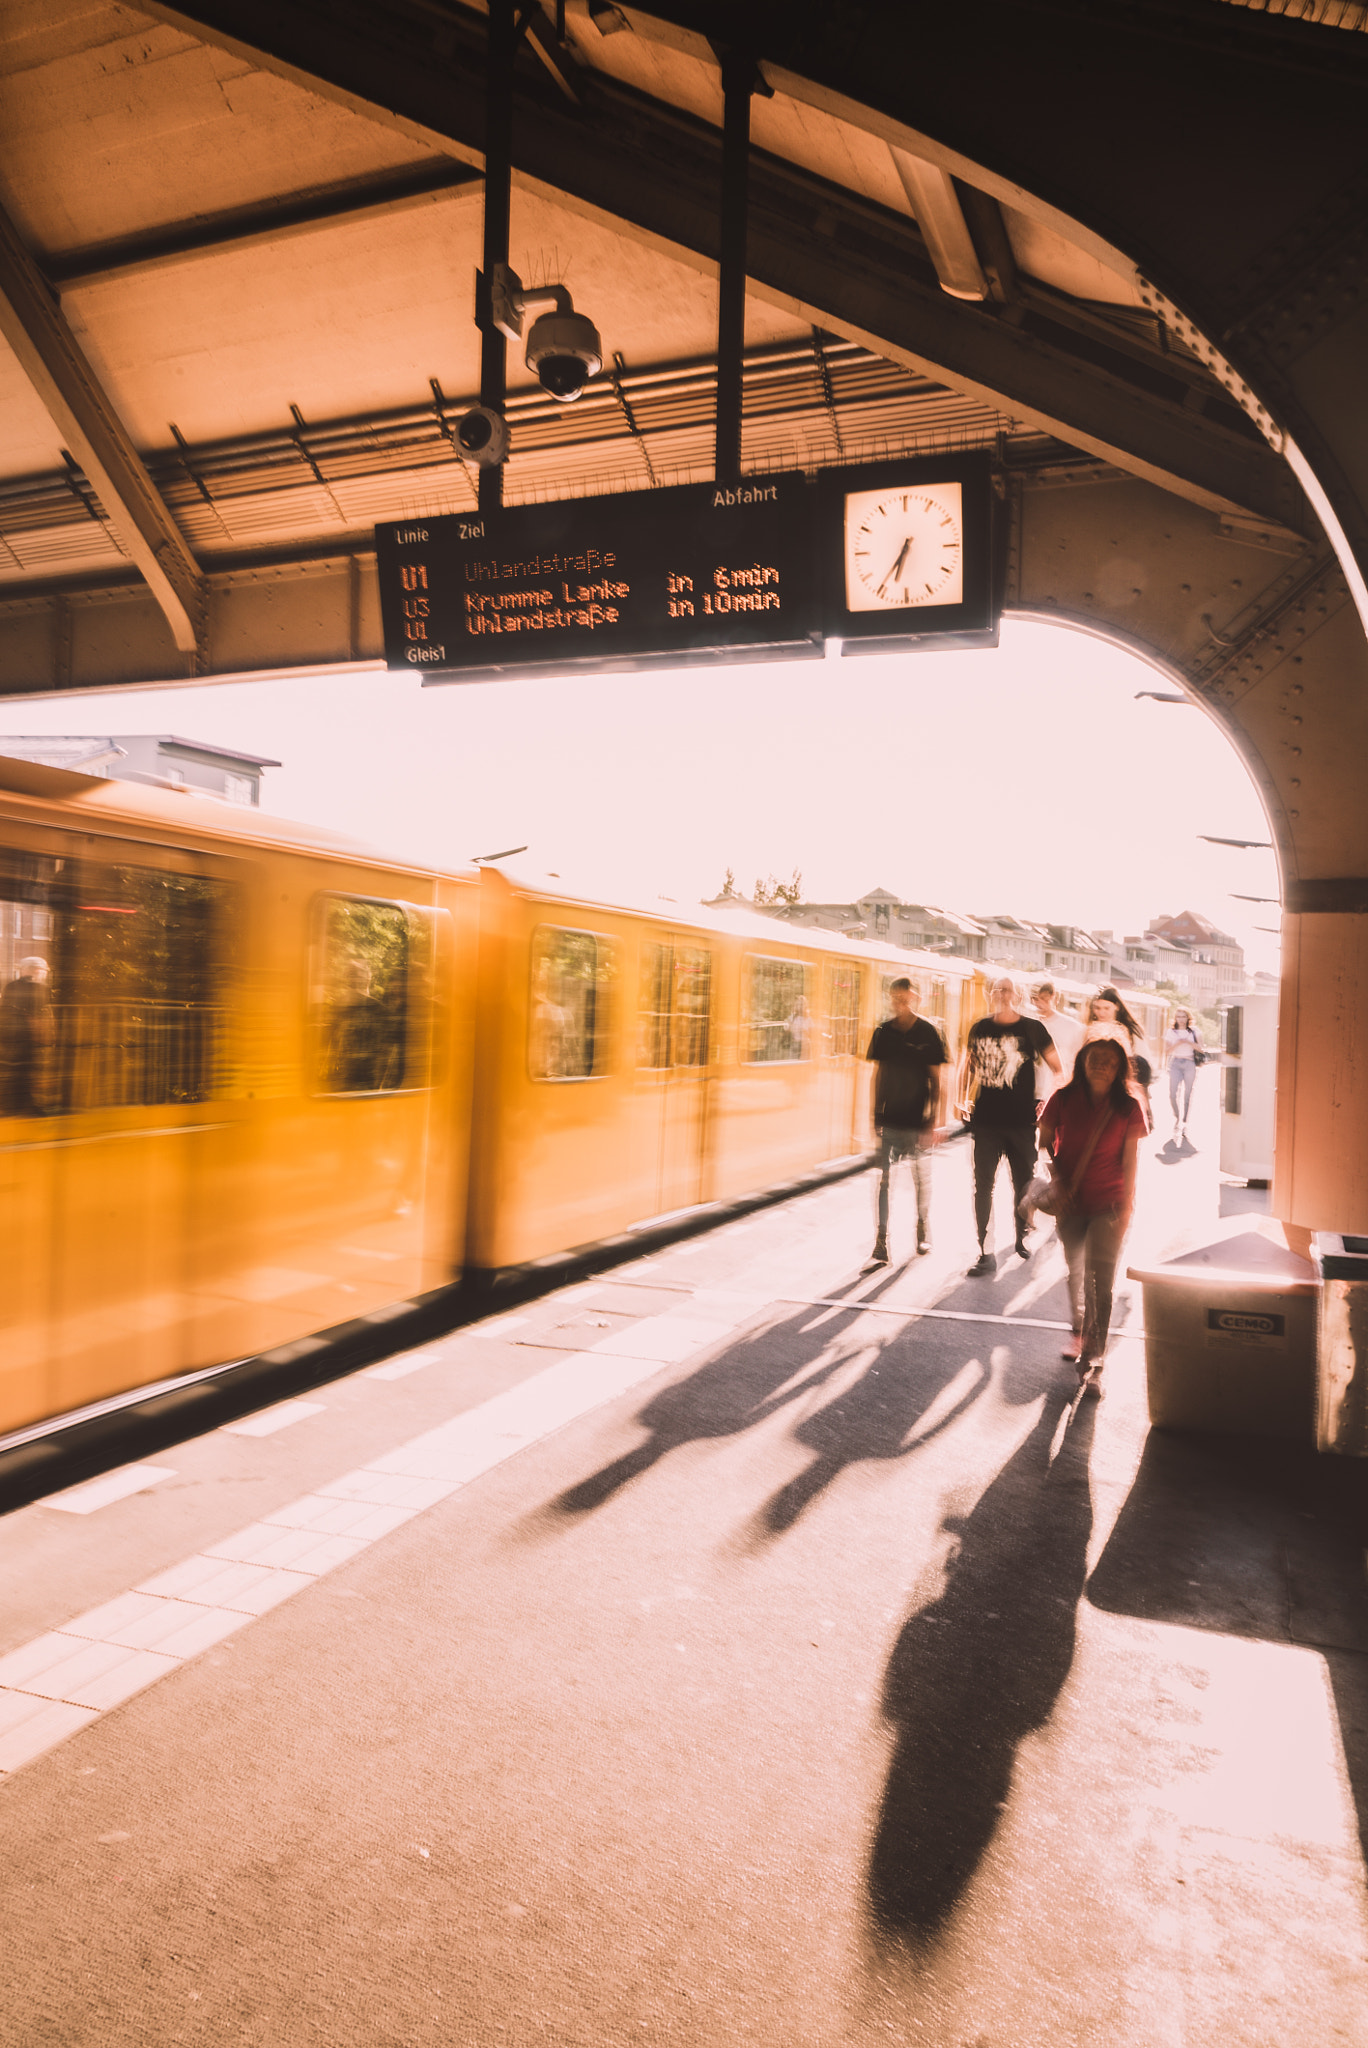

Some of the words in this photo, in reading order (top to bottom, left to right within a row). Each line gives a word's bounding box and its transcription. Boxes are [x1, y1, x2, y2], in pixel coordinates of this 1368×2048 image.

[397, 528, 429, 544] Linie
[459, 522, 485, 539] Ziel
[713, 486, 778, 507] Abfahrt
[400, 564, 428, 591] U1
[465, 549, 617, 582] Uhlandstraße
[464, 587, 554, 613] Krumme
[562, 578, 630, 603] Lanke
[667, 571, 693, 594] in
[404, 619, 428, 641] U1
[465, 604, 619, 632] Uhlandstraße
[667, 596, 694, 618] in
[1223, 1316, 1271, 1330] CEMO
